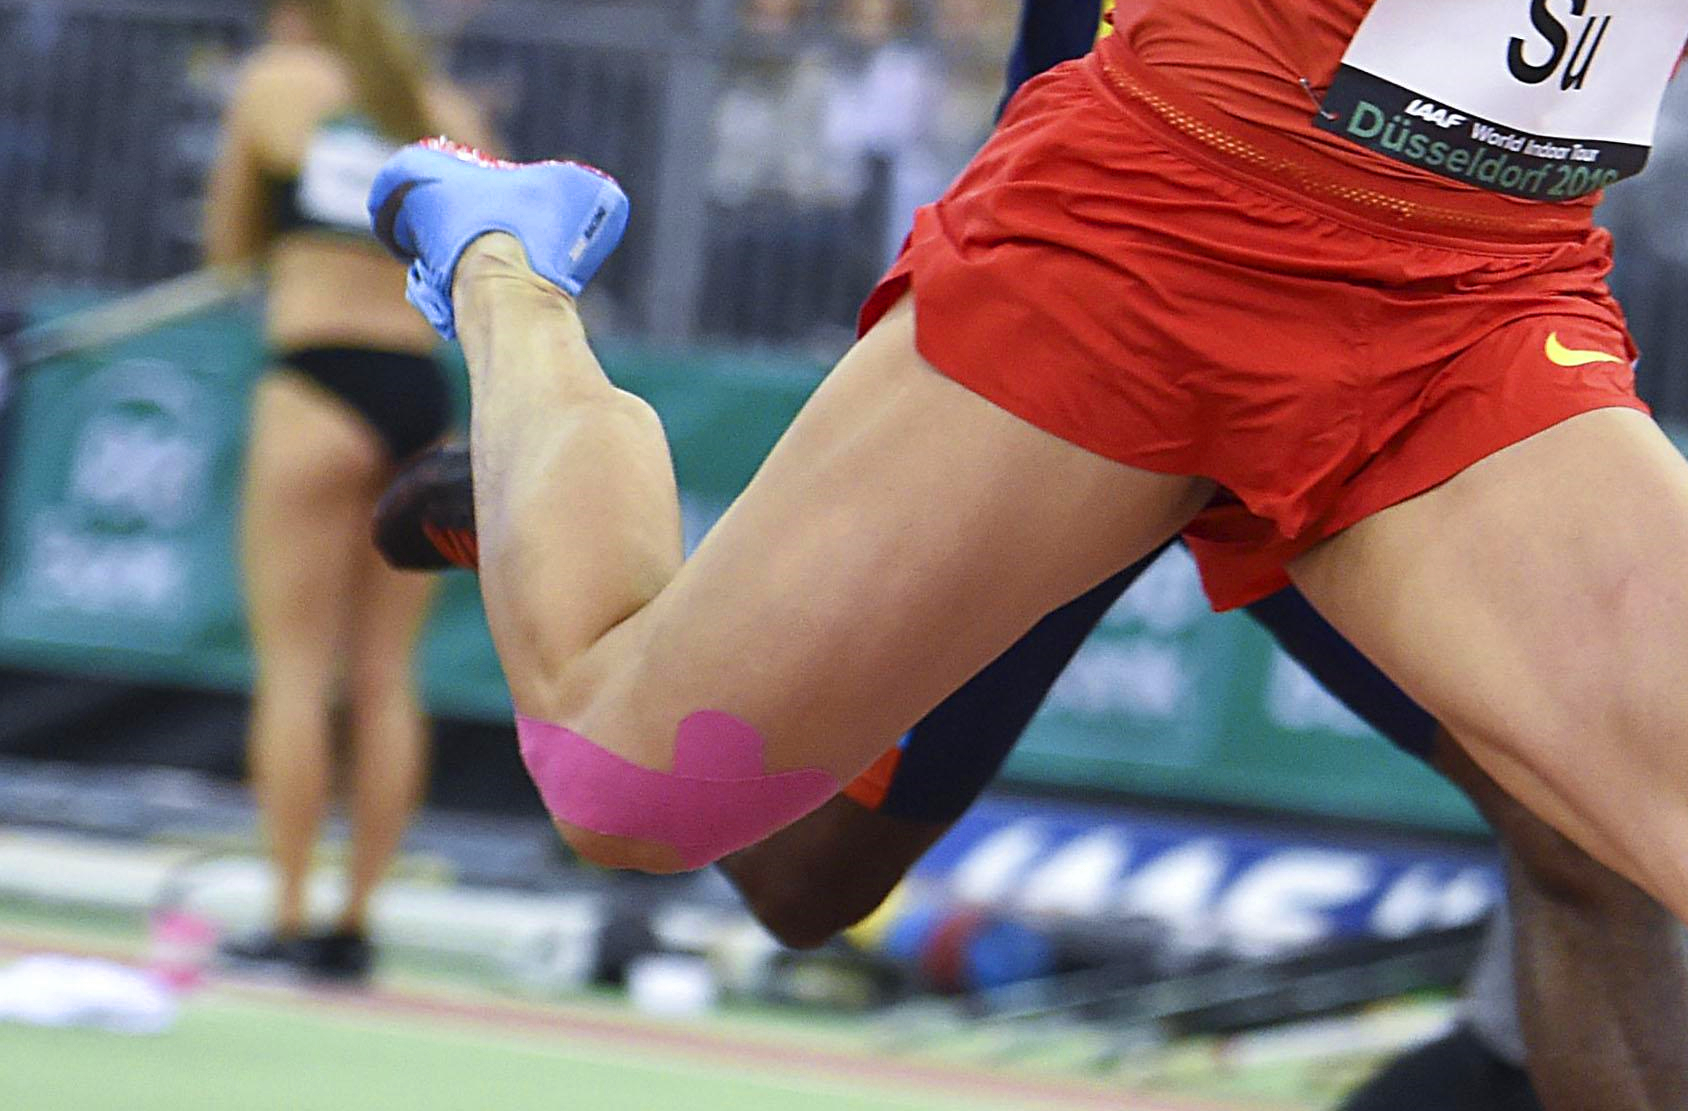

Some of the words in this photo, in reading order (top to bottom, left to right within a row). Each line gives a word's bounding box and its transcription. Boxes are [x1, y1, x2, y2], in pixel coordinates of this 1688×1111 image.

[1346, 99, 1553, 193] Düsseldorf
[1404, 99, 1469, 129] IAAF
[1471, 121, 1524, 152] World
[1523, 139, 1572, 161] Indoor
[1570, 143, 1600, 163] Tour
